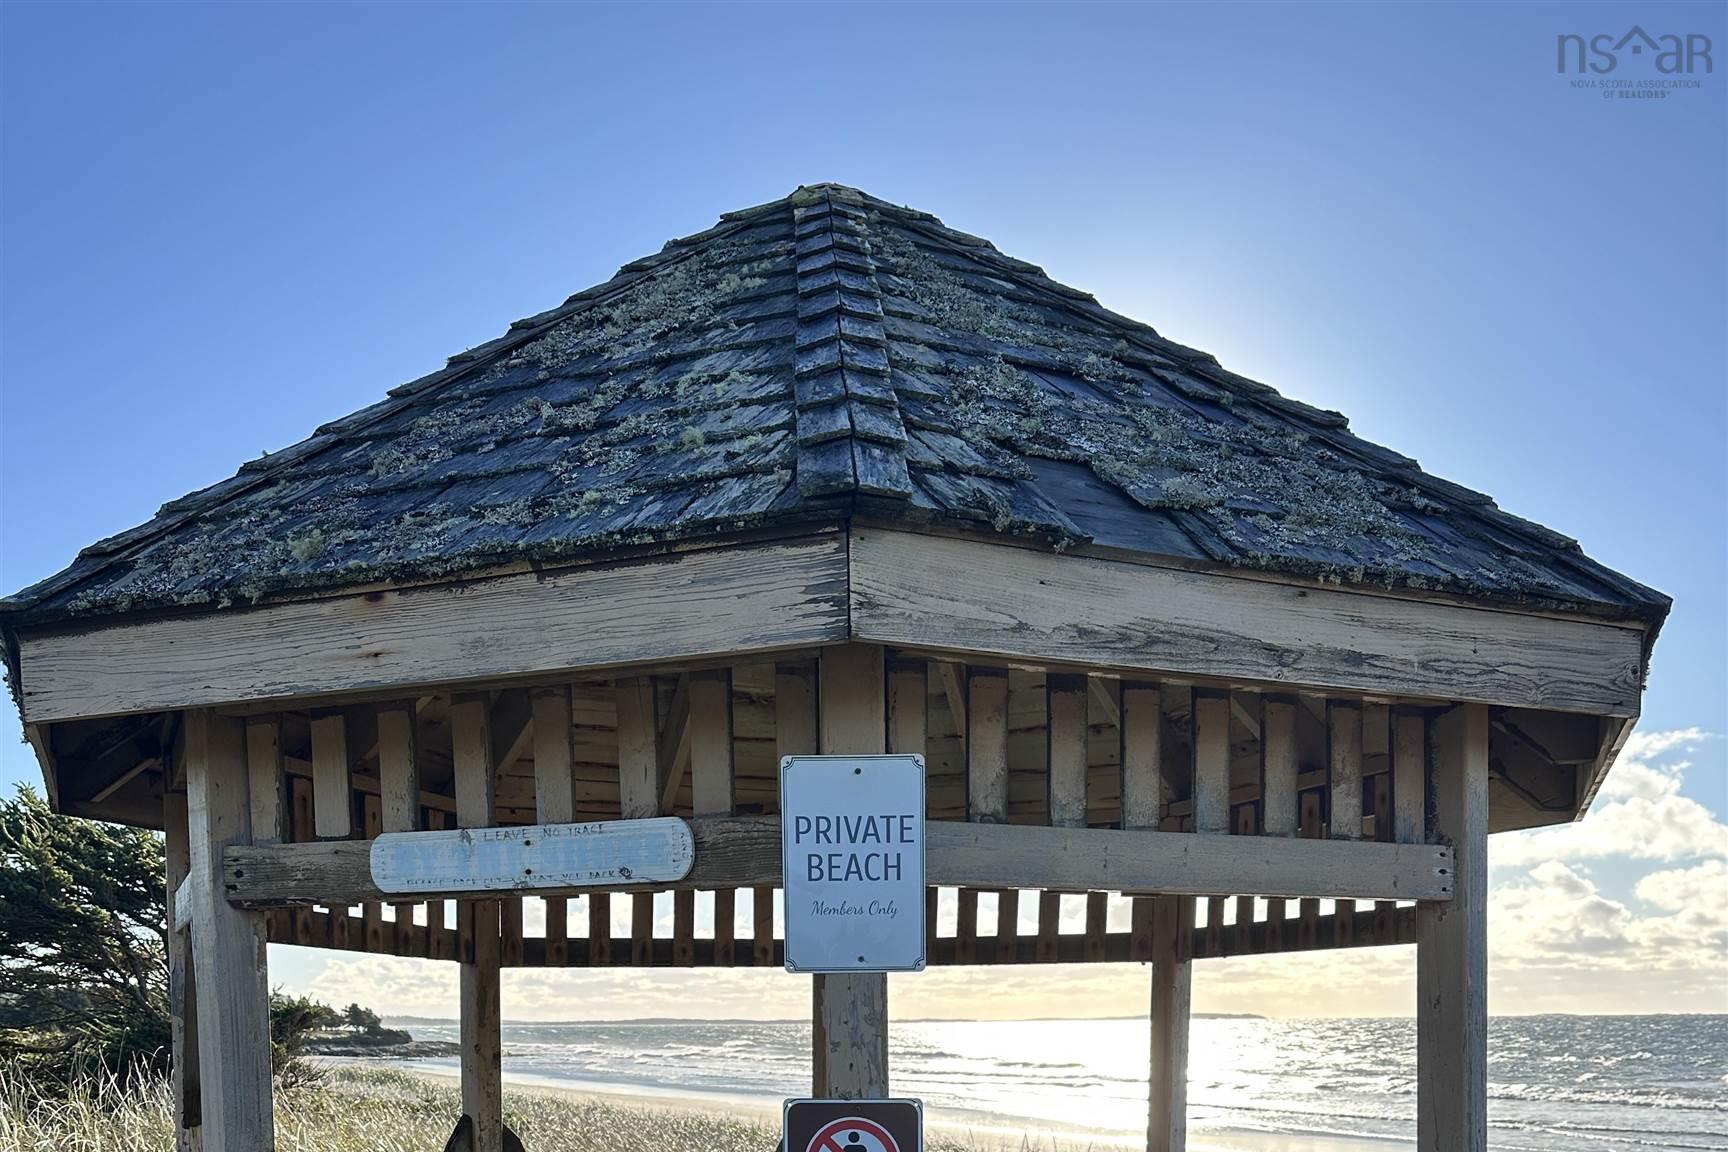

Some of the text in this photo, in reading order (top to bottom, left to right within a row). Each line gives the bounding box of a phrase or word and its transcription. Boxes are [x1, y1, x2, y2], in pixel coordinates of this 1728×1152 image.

[484, 828, 530, 842] LEAVE
[795, 815, 915, 844] PRIVATE
[807, 853, 901, 882] BEACH
[810, 900, 898, 918] Members Only
